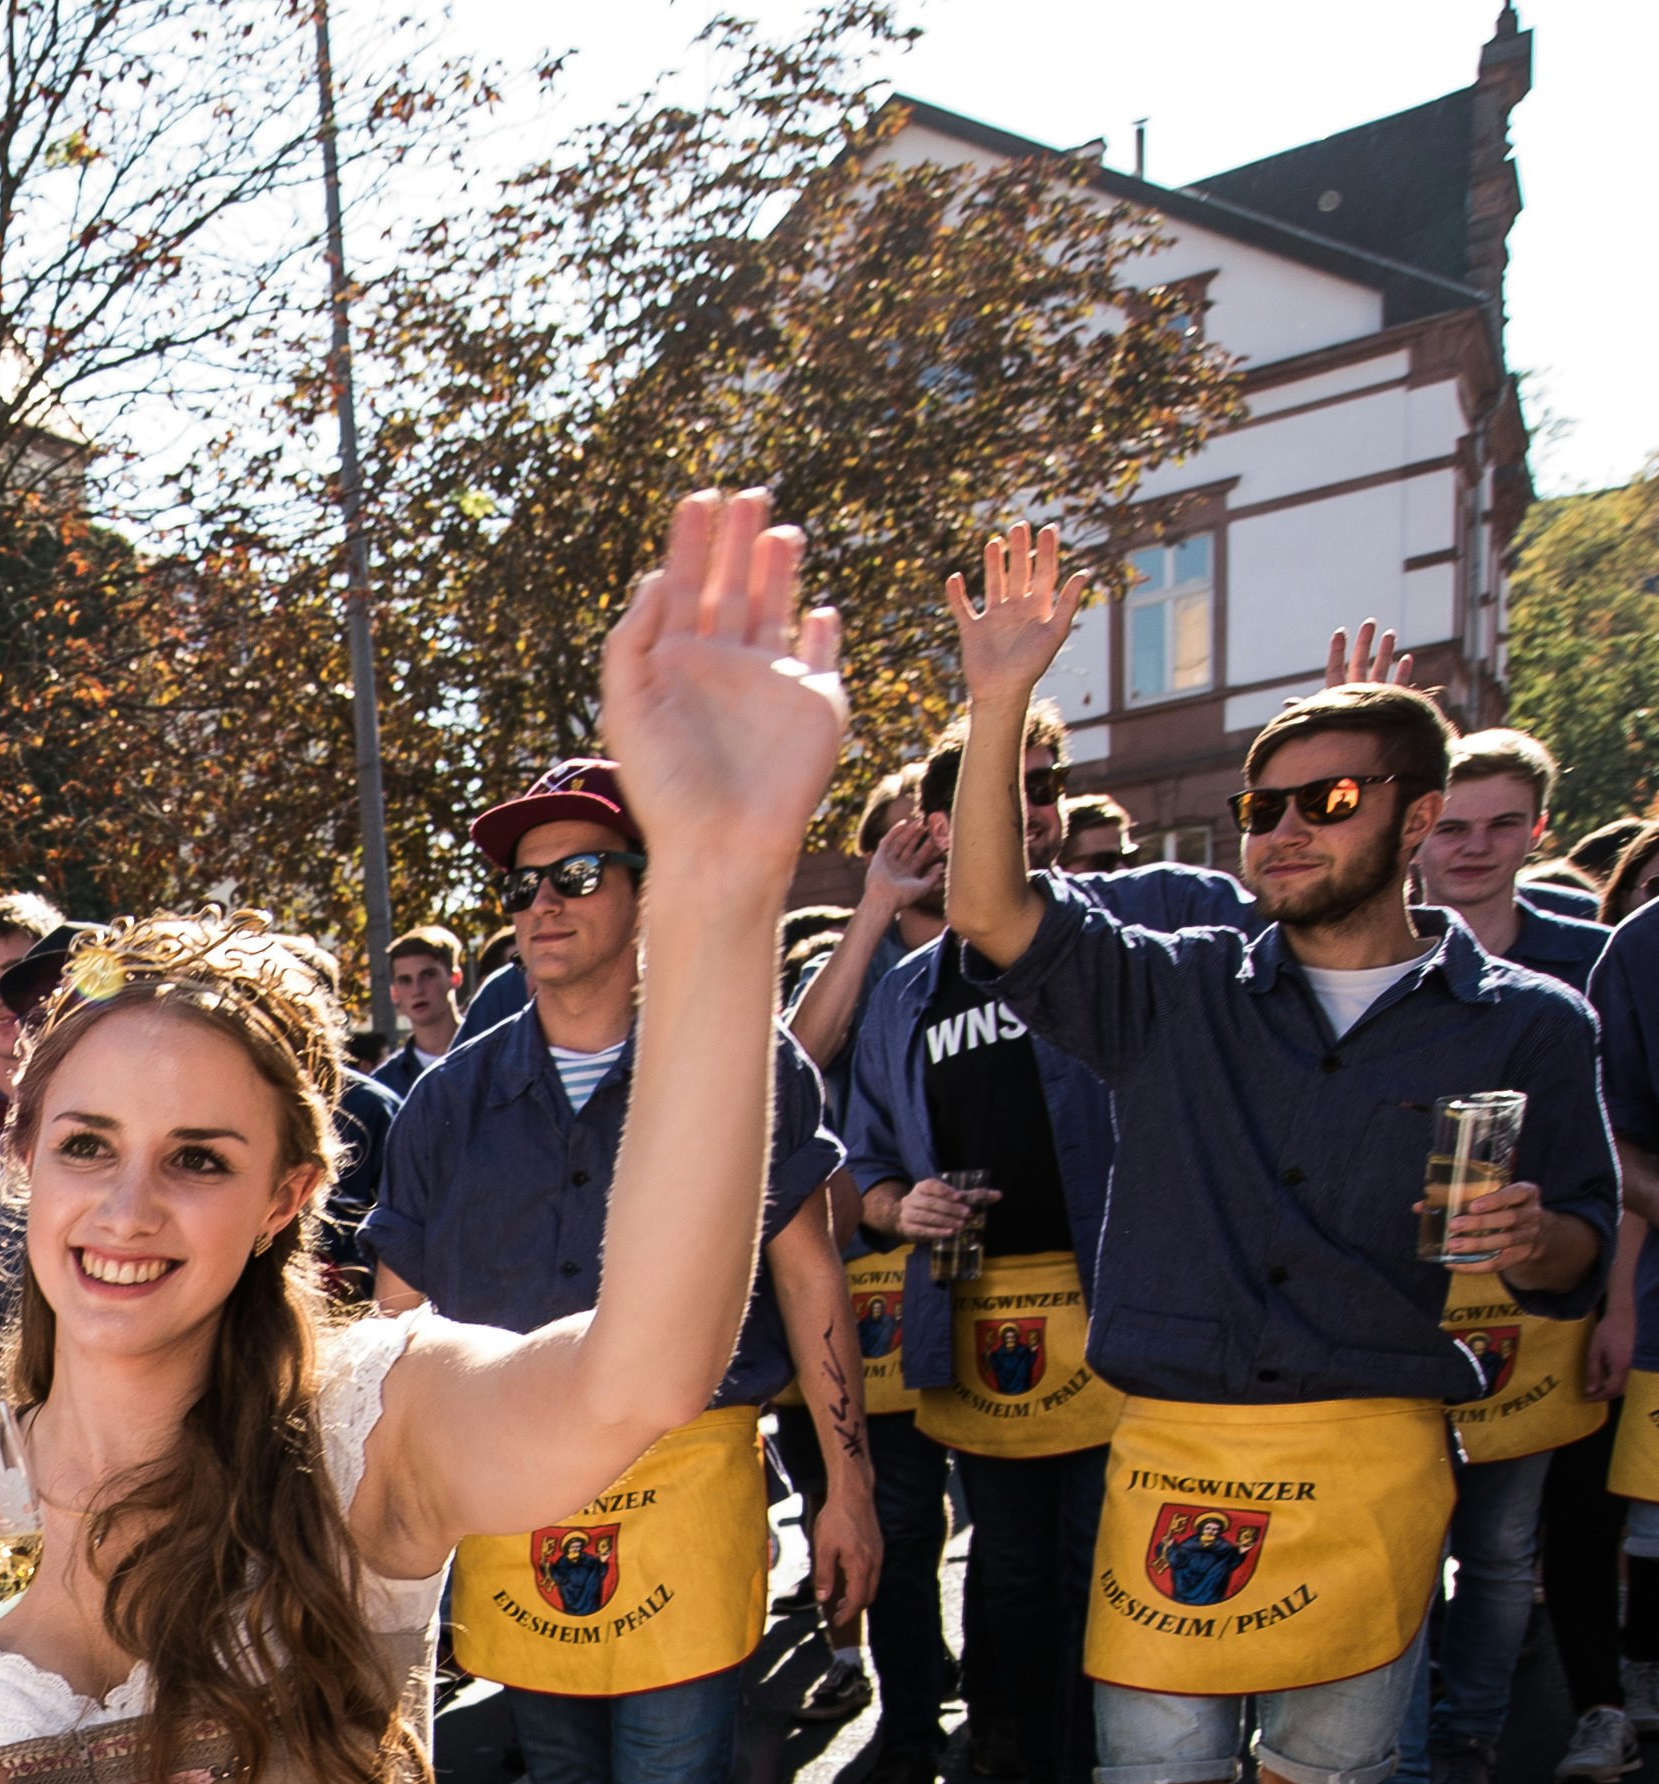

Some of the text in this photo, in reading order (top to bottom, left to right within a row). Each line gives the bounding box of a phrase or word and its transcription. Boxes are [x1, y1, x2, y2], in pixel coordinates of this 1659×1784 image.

[1042, 1368, 1092, 1411] PFALZ
[1126, 1469, 1317, 1501] JUNGWINZER
[613, 1584, 675, 1638] PFALZ
[1235, 1583, 1318, 1635] PFALZ
